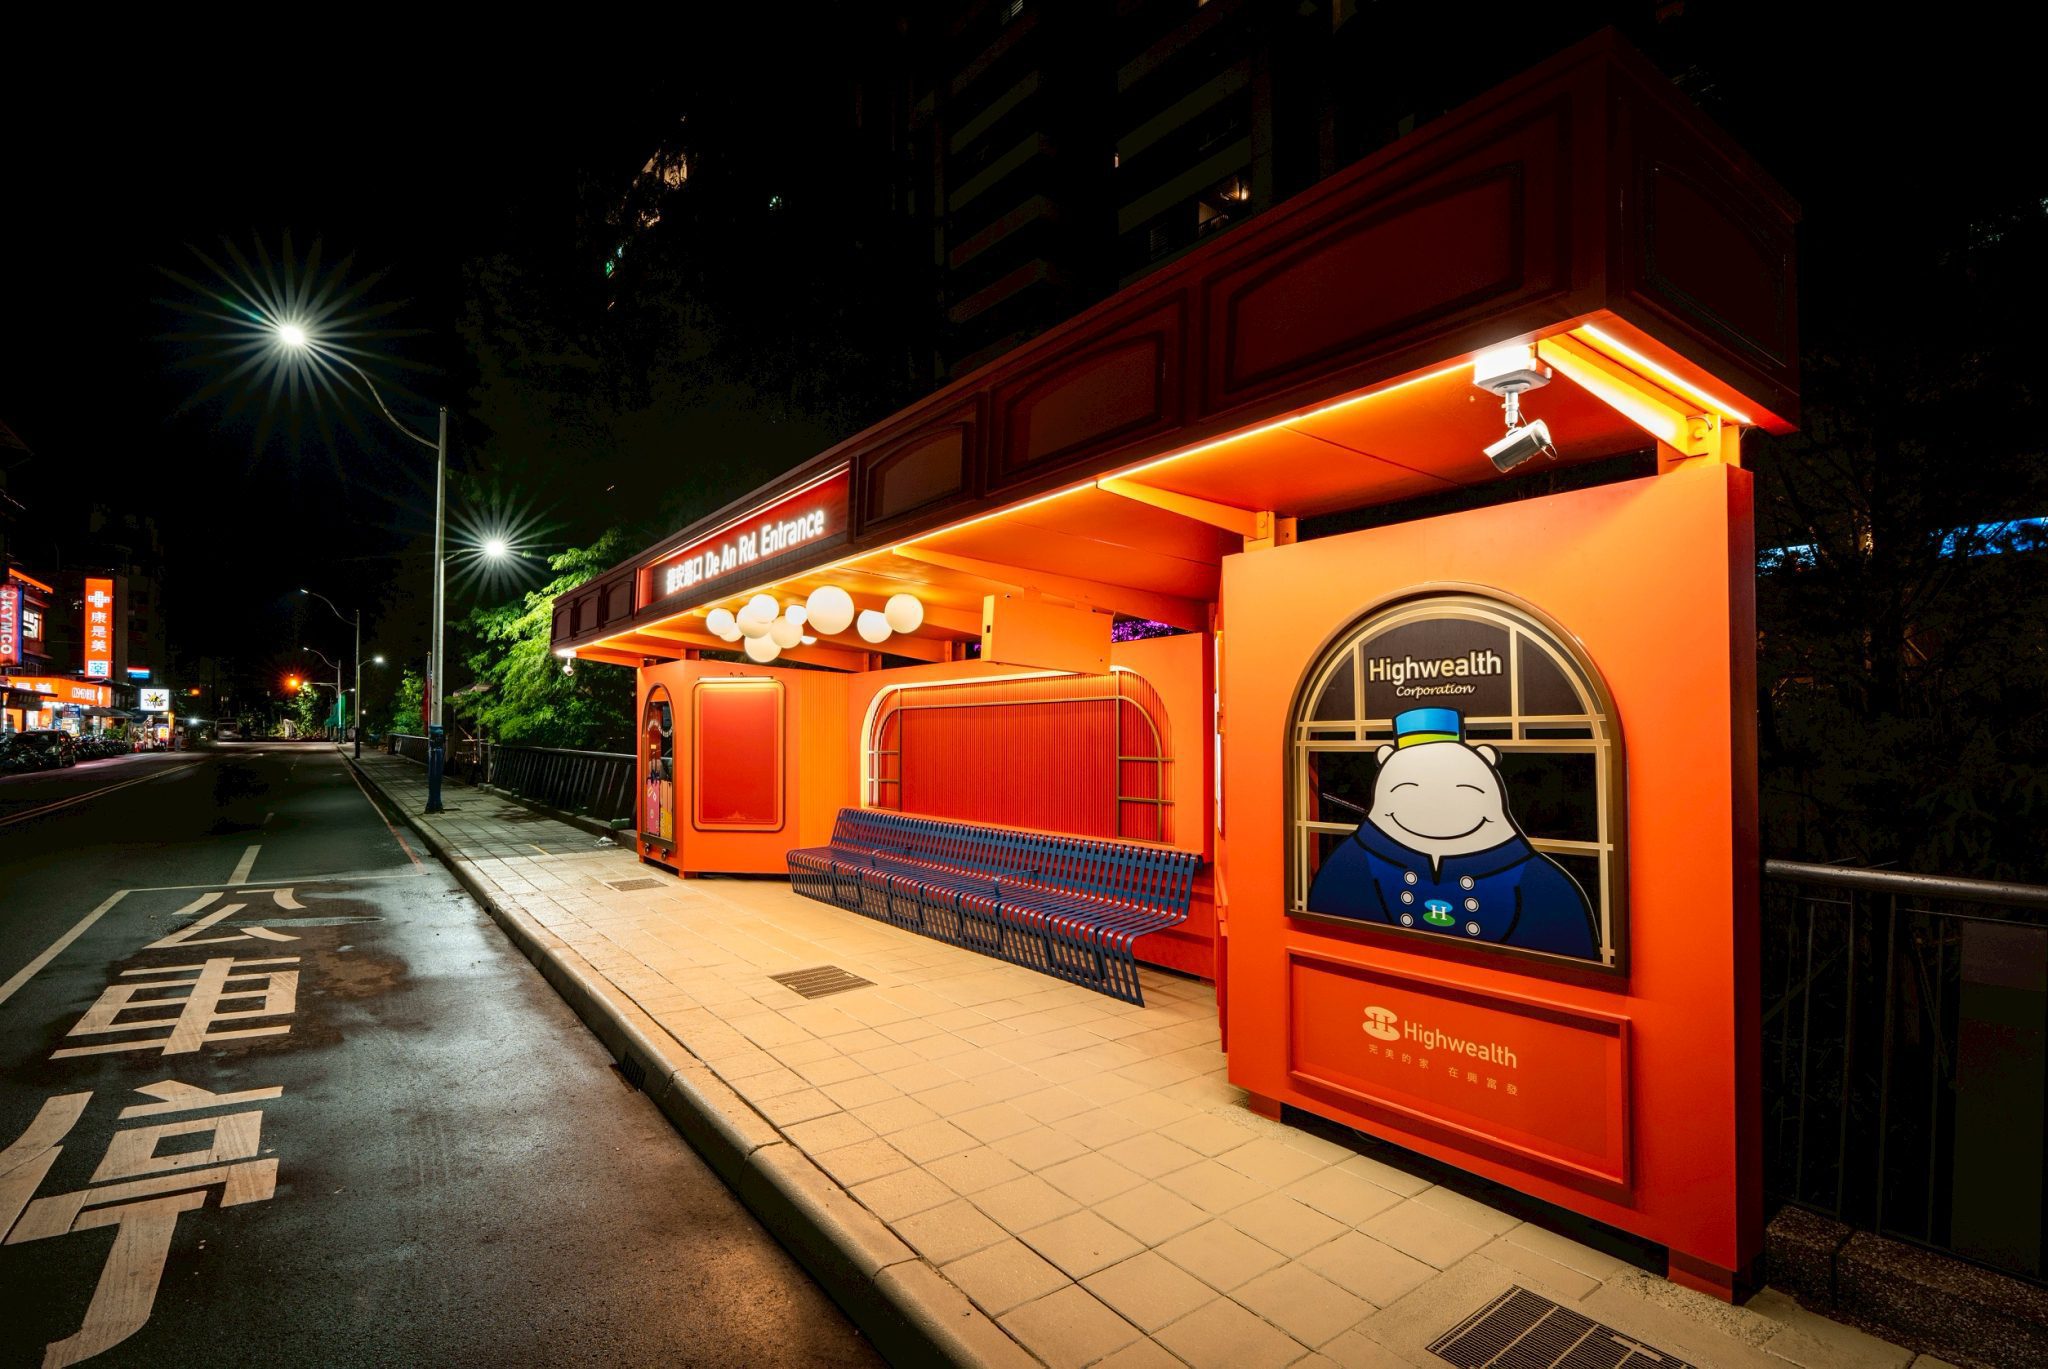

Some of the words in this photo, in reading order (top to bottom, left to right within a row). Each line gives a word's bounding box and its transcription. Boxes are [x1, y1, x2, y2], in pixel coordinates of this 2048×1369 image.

[705, 551, 720, 578] De
[721, 544, 736, 572] An
[738, 532, 758, 564] Rd.
[761, 510, 825, 557] Entrance
[0, 601, 13, 655] KYMCO
[91, 611, 107, 652] 康是美
[1368, 650, 1503, 686] Highwealth
[1396, 684, 1475, 700] Corporation
[1404, 1020, 1518, 1069] Highwealth
[1368, 1044, 1429, 1070] 完美的家
[1448, 1067, 1518, 1096] 在興富發
